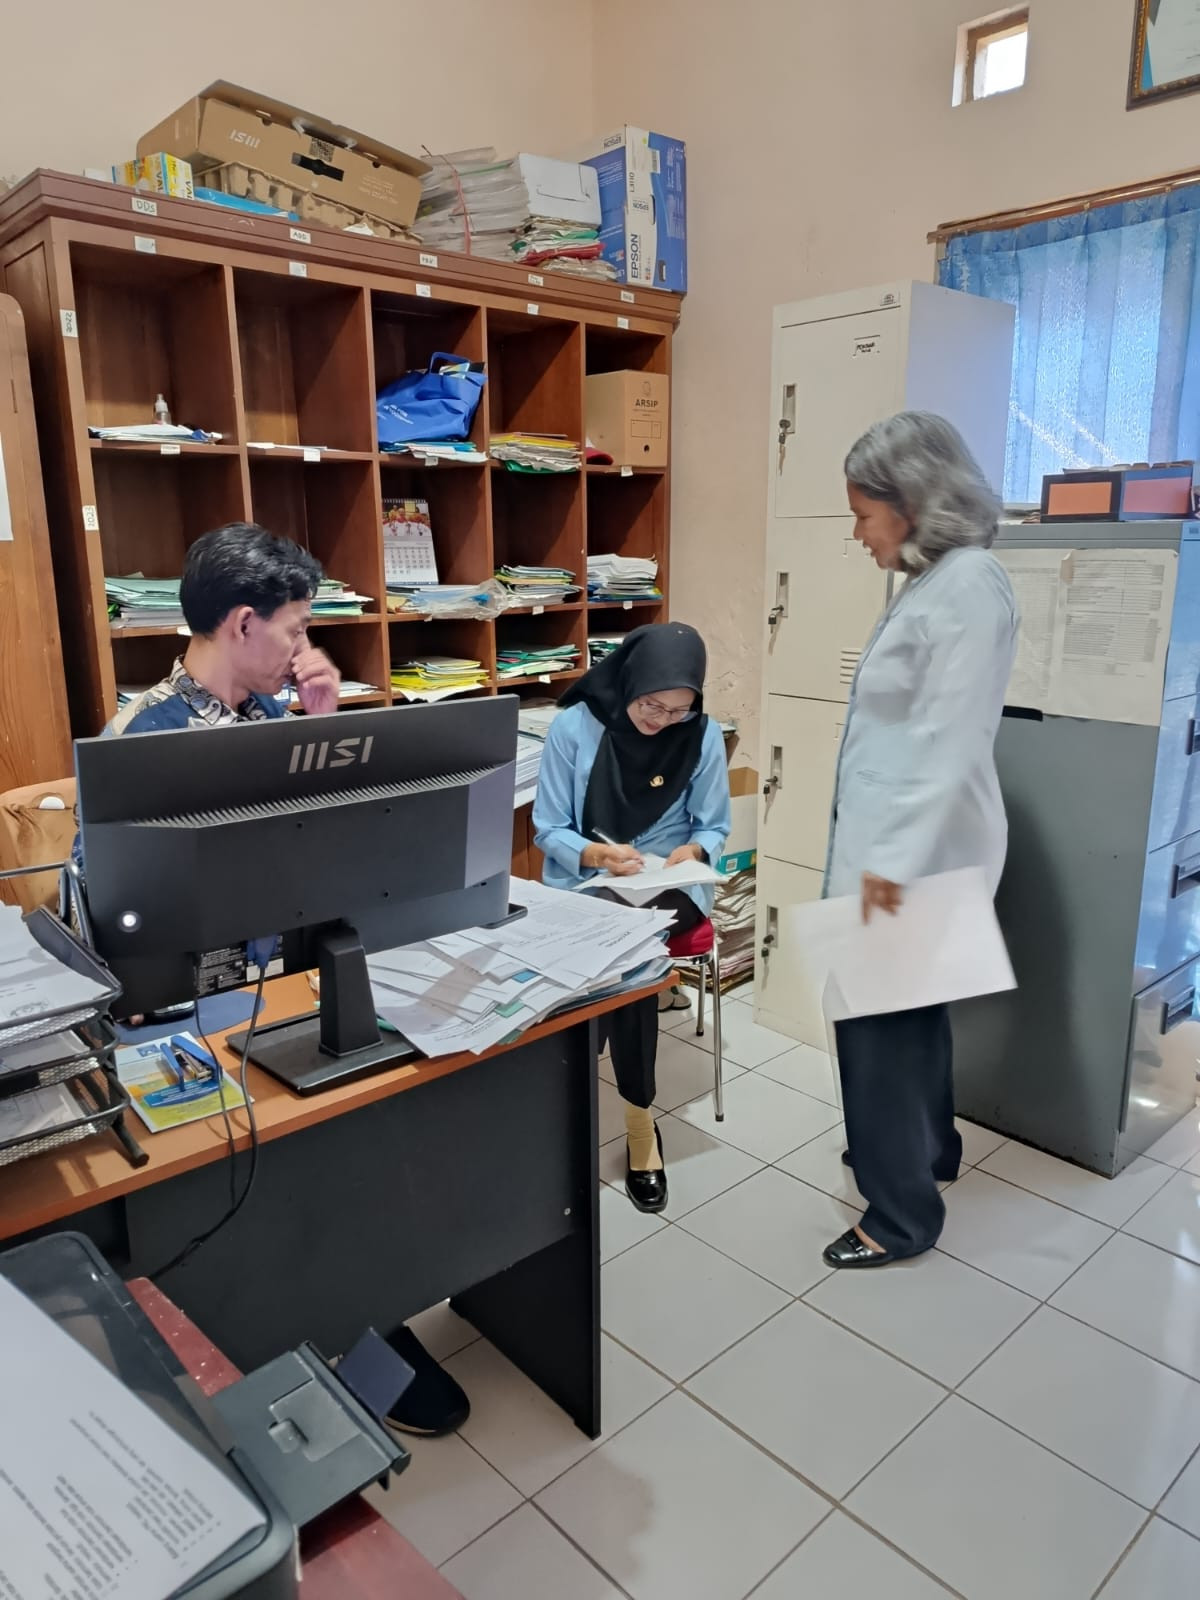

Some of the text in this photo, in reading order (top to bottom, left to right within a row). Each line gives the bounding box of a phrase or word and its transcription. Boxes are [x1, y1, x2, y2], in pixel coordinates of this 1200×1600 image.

[630, 233, 640, 279] EPSON
[65, 312, 73, 333] 2022
[635, 398, 659, 409] ARSIP
[288, 735, 375, 774] MSI
